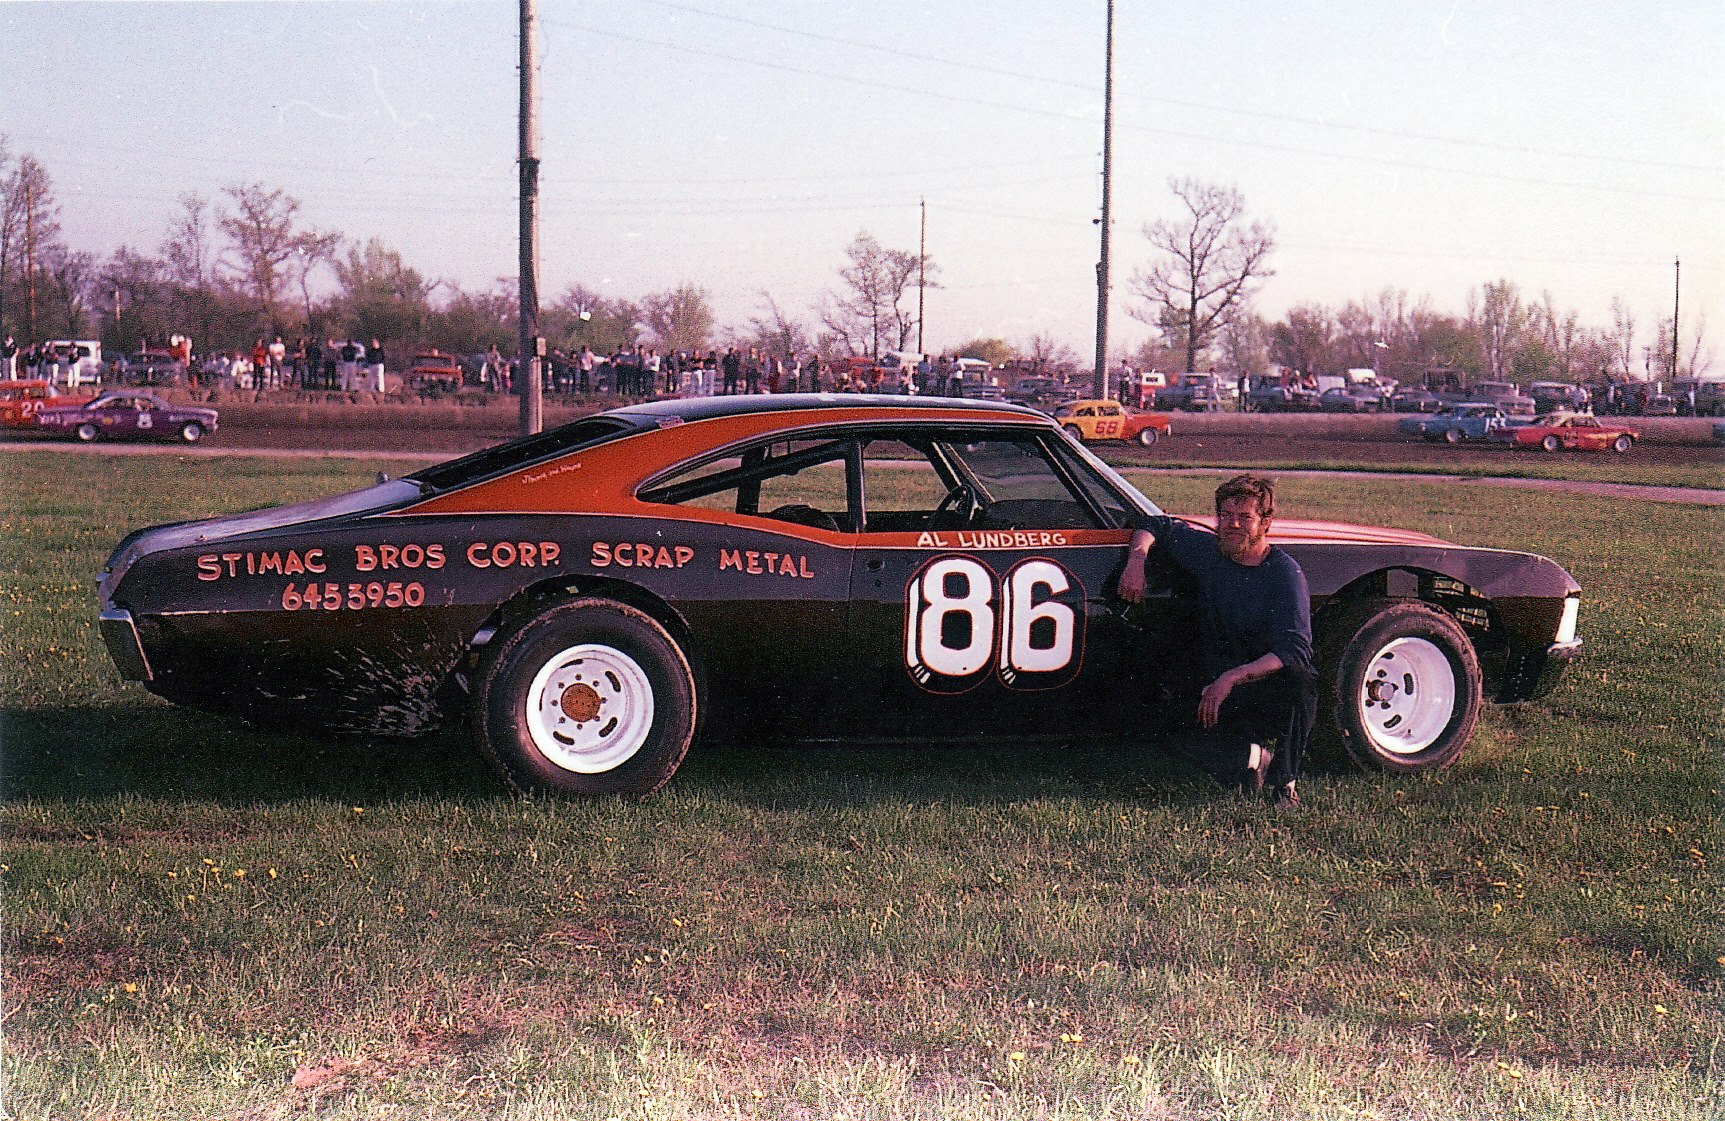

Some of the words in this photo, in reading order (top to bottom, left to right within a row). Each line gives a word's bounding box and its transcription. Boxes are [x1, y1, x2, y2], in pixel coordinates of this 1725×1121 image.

[1095, 420, 1119, 435] 68
[917, 531, 948, 547] AL
[959, 532, 1067, 548] LUNDBERG
[197, 548, 327, 581] STIMAC
[355, 544, 446, 571] BROS
[467, 542, 560, 568] CORP.
[590, 542, 694, 569] SCRAP
[719, 549, 815, 579] METAL
[907, 558, 1075, 682] 86
